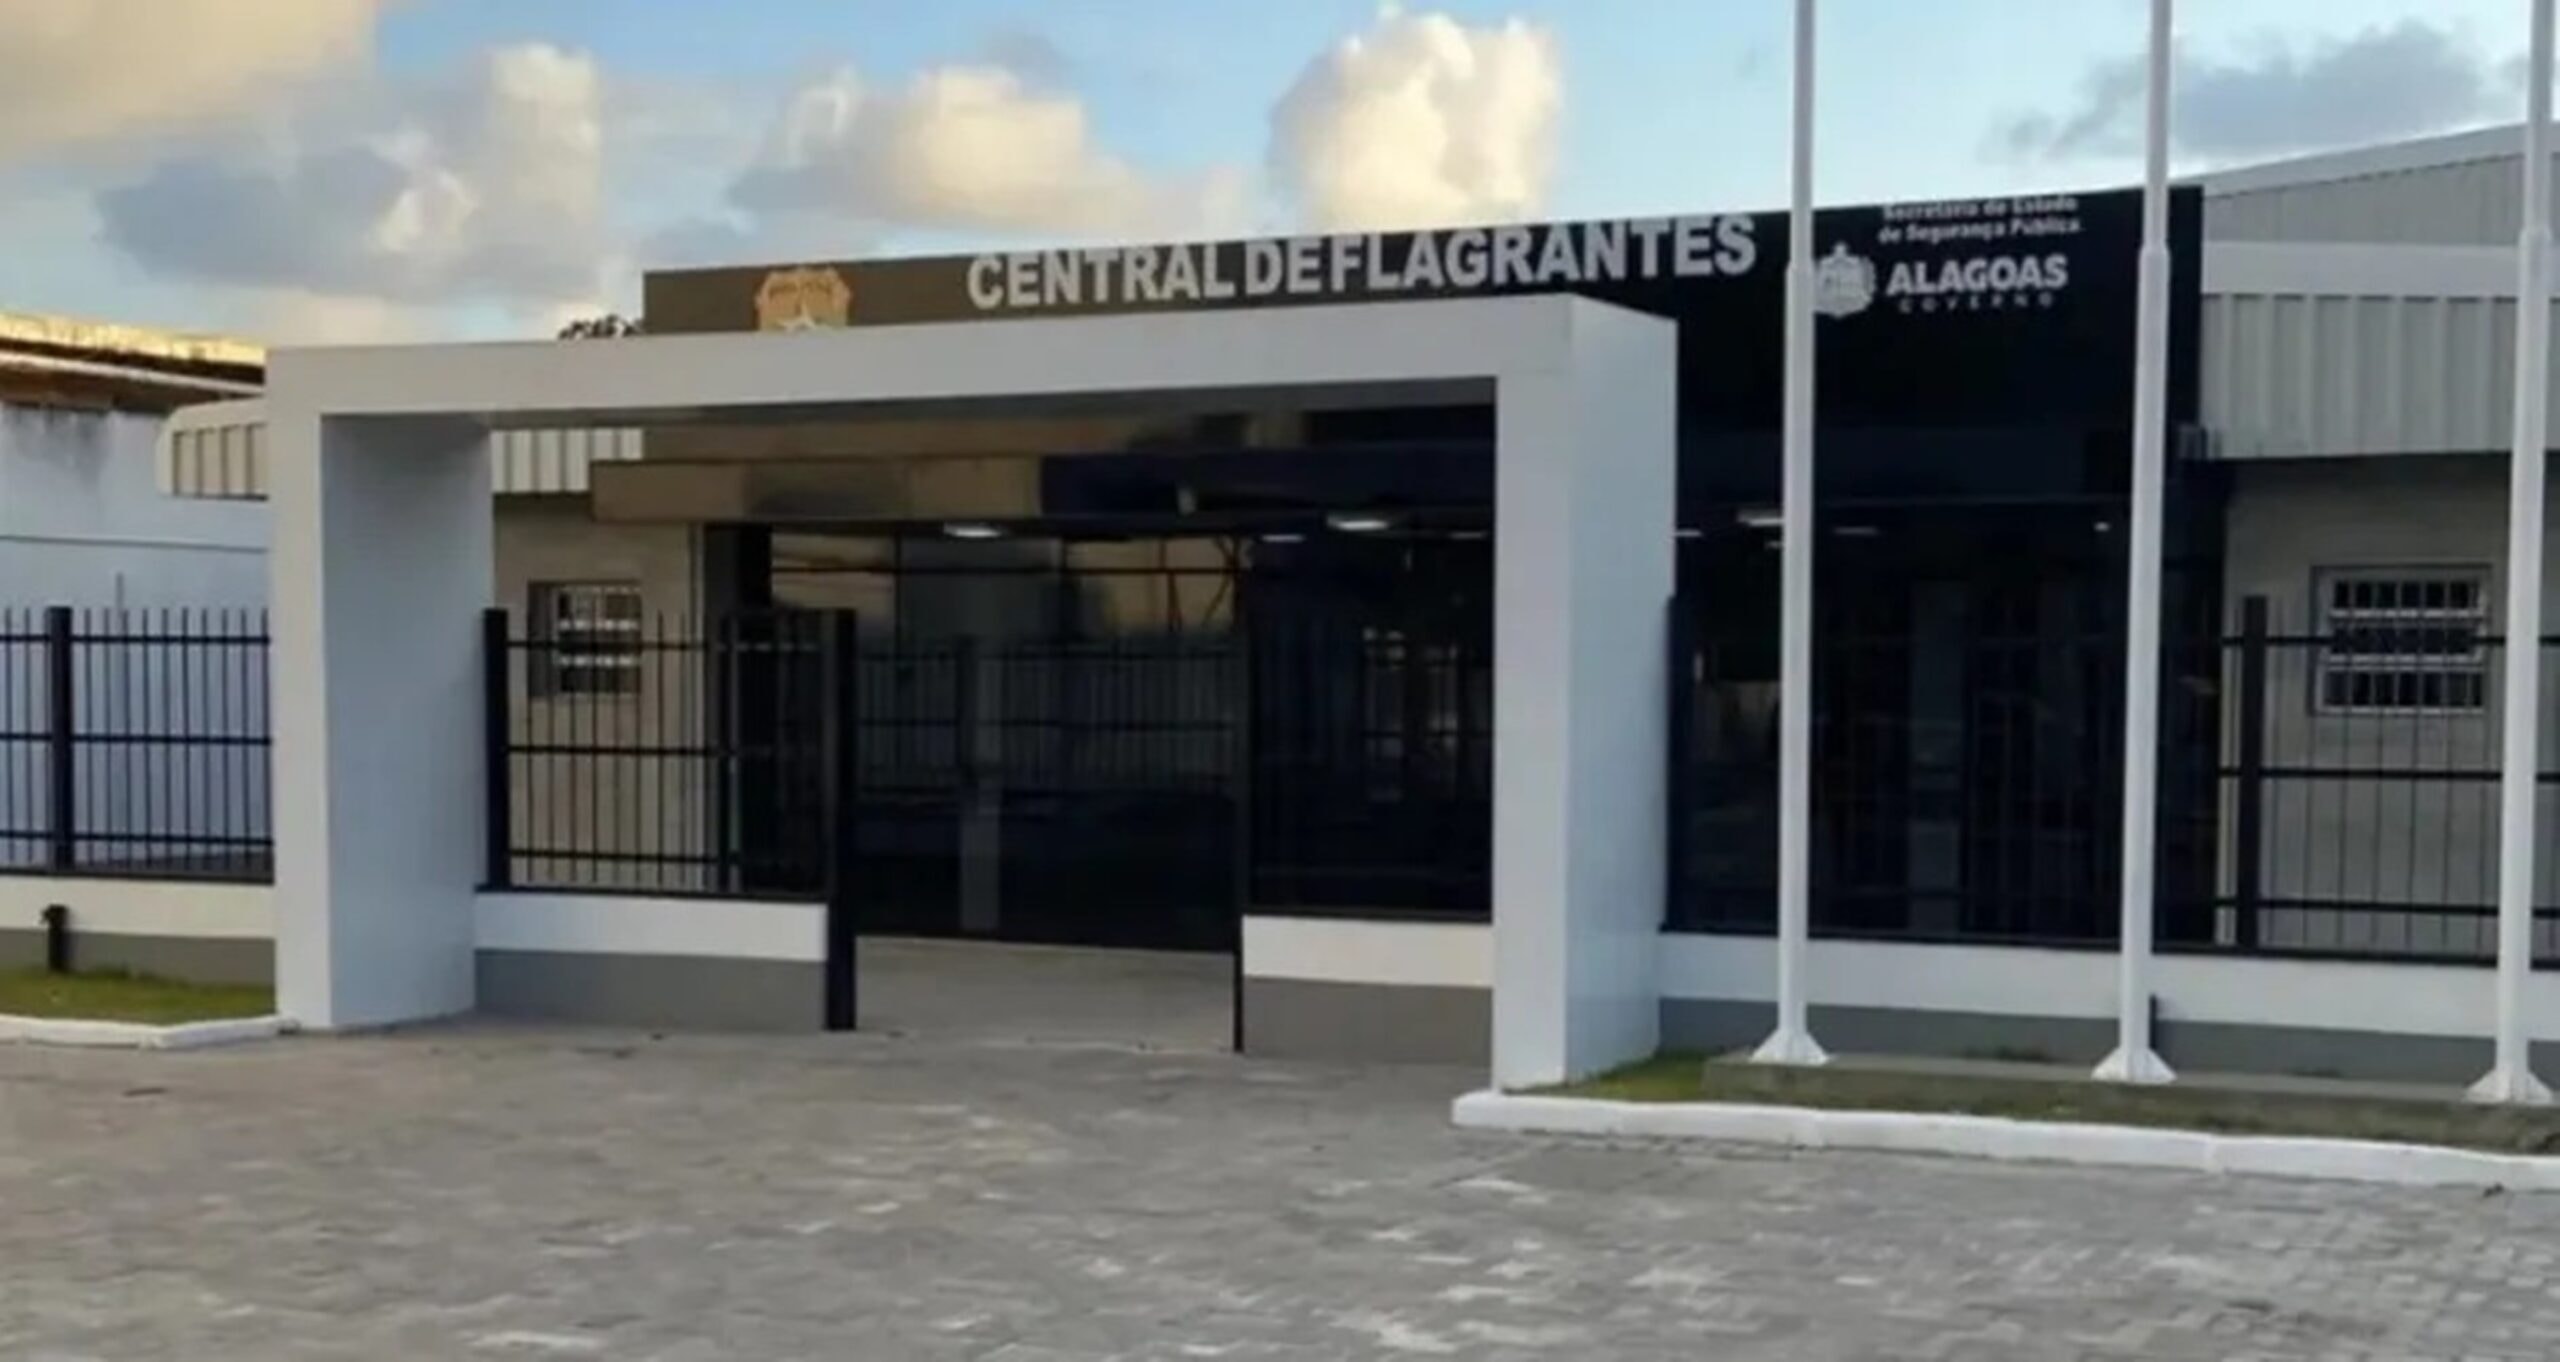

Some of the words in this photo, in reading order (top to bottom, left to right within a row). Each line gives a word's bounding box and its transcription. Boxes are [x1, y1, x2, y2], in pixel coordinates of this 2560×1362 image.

[1878, 226, 1901, 244] de
[1905, 222, 2005, 245] Segurança
[967, 244, 1235, 309] CENTRAL
[1245, 236, 1322, 295] DE
[1330, 213, 1757, 292] FLAGRANTES
[1886, 254, 2068, 296] ALAGOAS
[1900, 292, 2053, 313] GOVERNO
